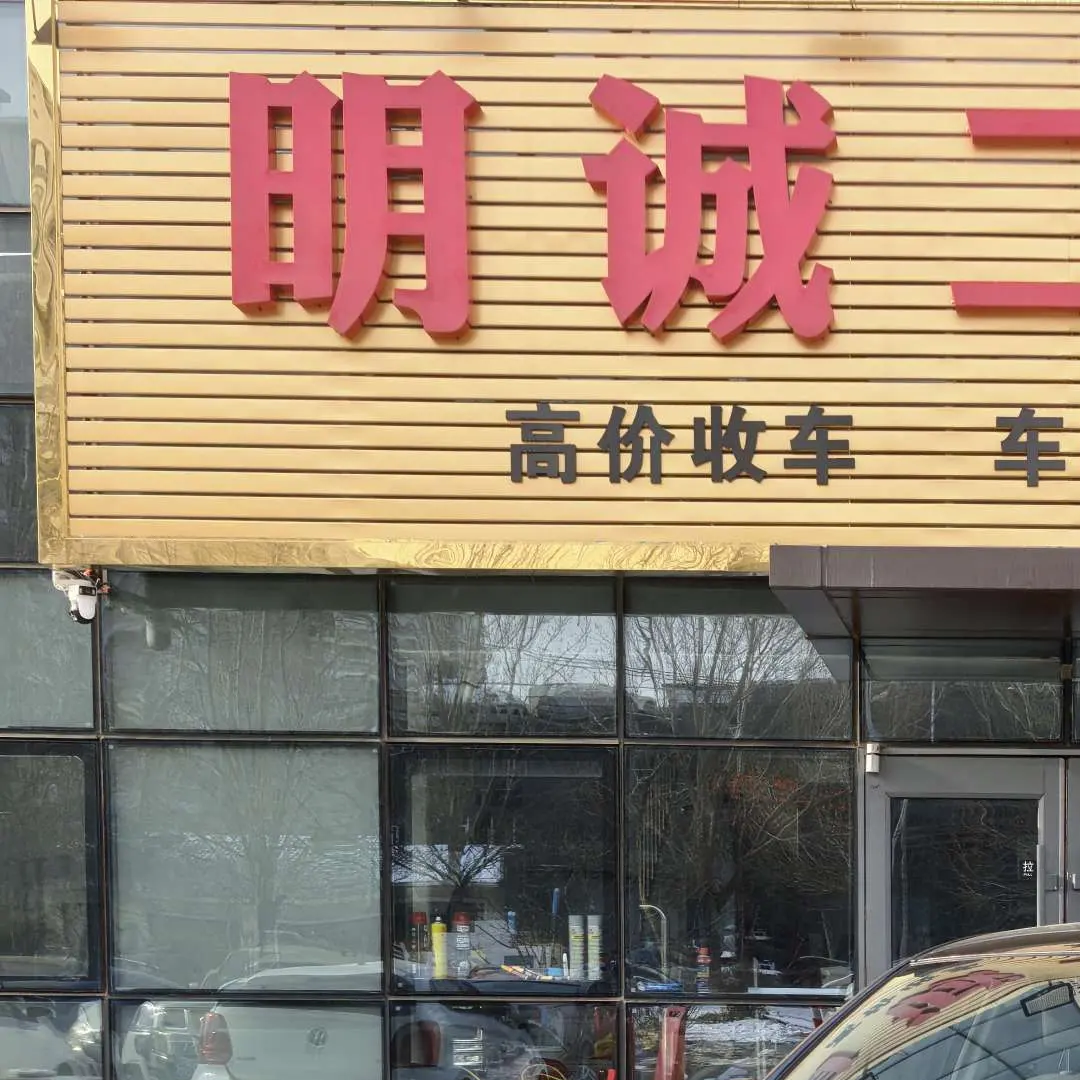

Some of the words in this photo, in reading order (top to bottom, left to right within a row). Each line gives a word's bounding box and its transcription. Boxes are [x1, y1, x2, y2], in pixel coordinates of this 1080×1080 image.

[505, 402, 856, 487] 高价收车
[1022, 860, 1034, 873] 拉
